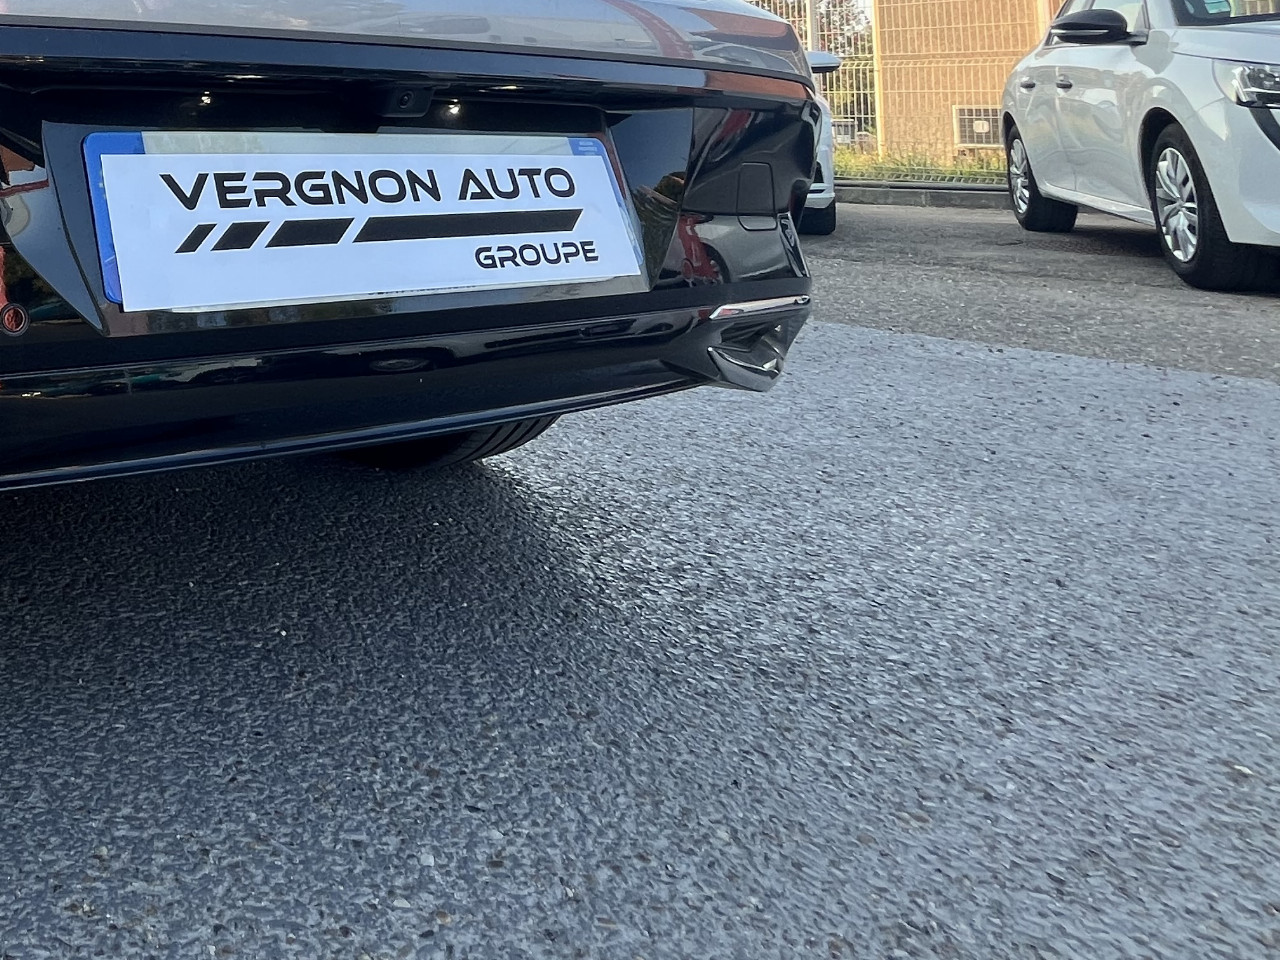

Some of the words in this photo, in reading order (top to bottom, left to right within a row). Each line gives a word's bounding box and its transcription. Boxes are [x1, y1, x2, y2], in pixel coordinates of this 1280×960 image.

[159, 169, 442, 211] VERGNON
[458, 166, 577, 202] AUTO
[474, 240, 600, 270] GROUPE
